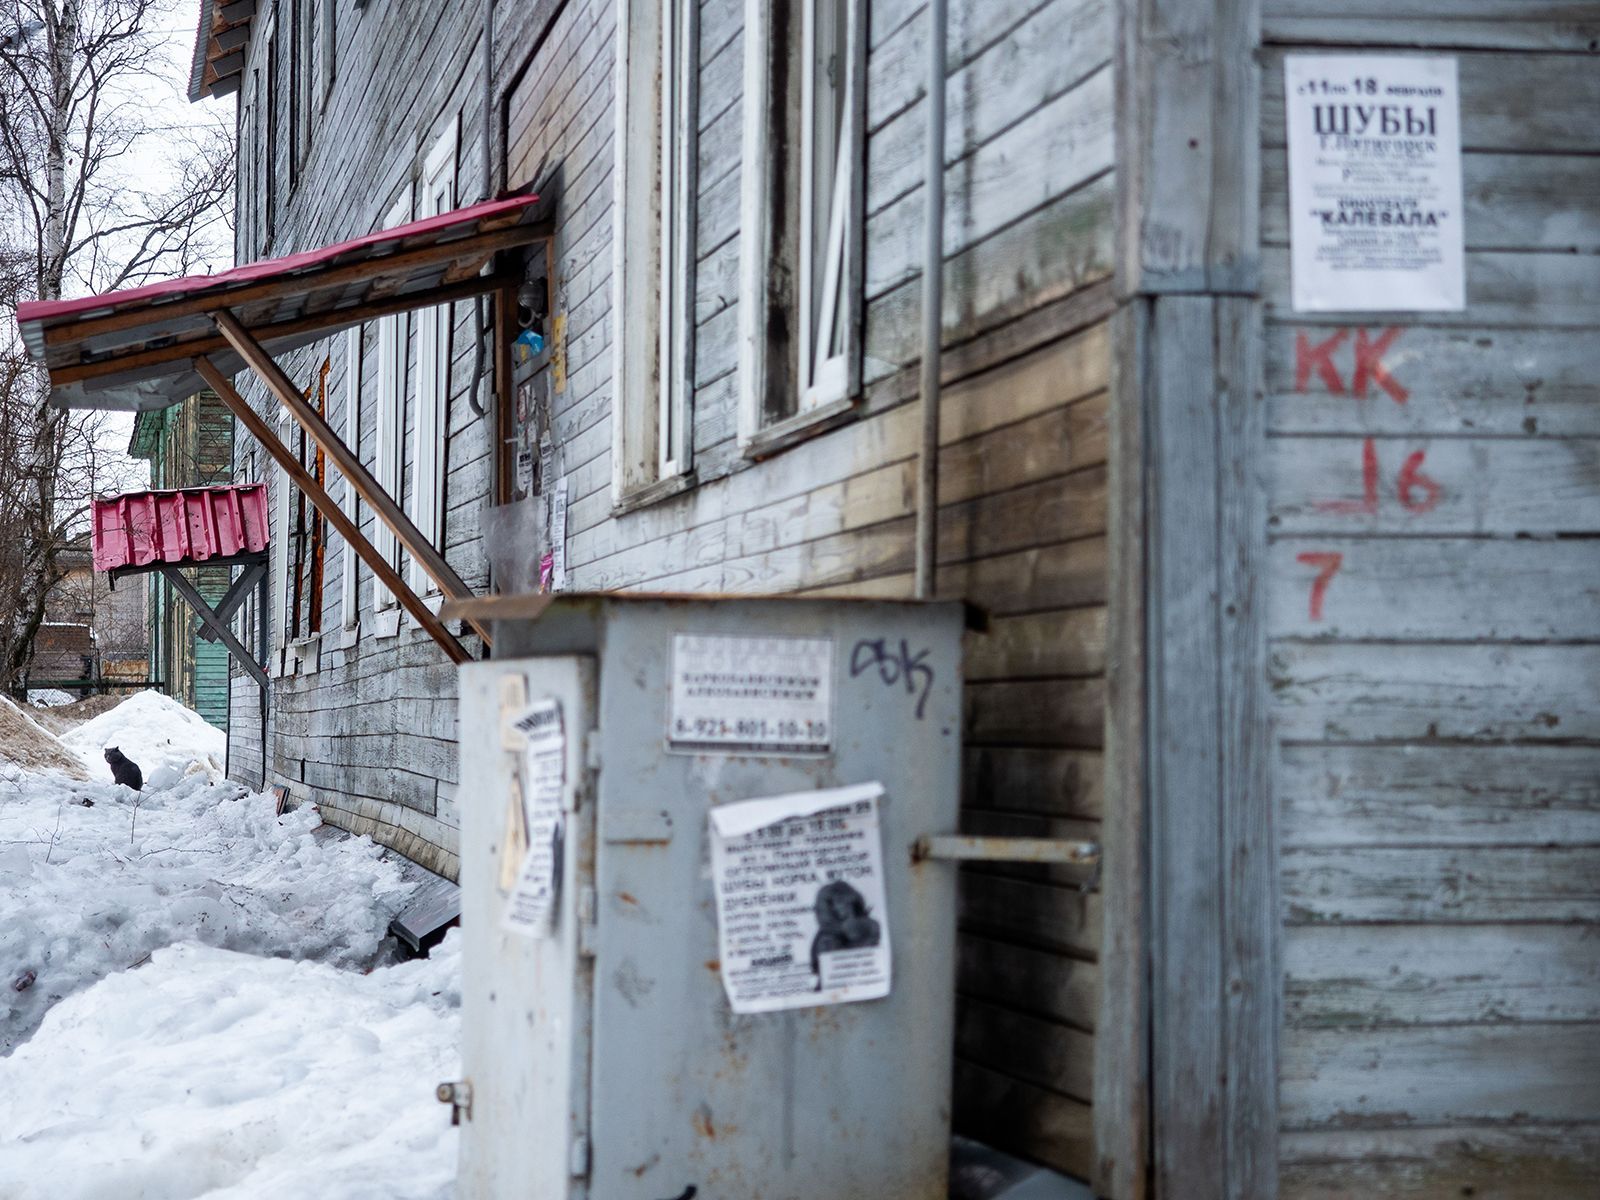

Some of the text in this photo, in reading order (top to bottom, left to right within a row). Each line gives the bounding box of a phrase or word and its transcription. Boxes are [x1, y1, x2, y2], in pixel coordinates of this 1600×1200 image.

[1308, 79, 1328, 95] 11
[1354, 77, 1377, 95] 18
[1313, 103, 1437, 136] ШУБЫ
[1296, 552, 1344, 621] 7
